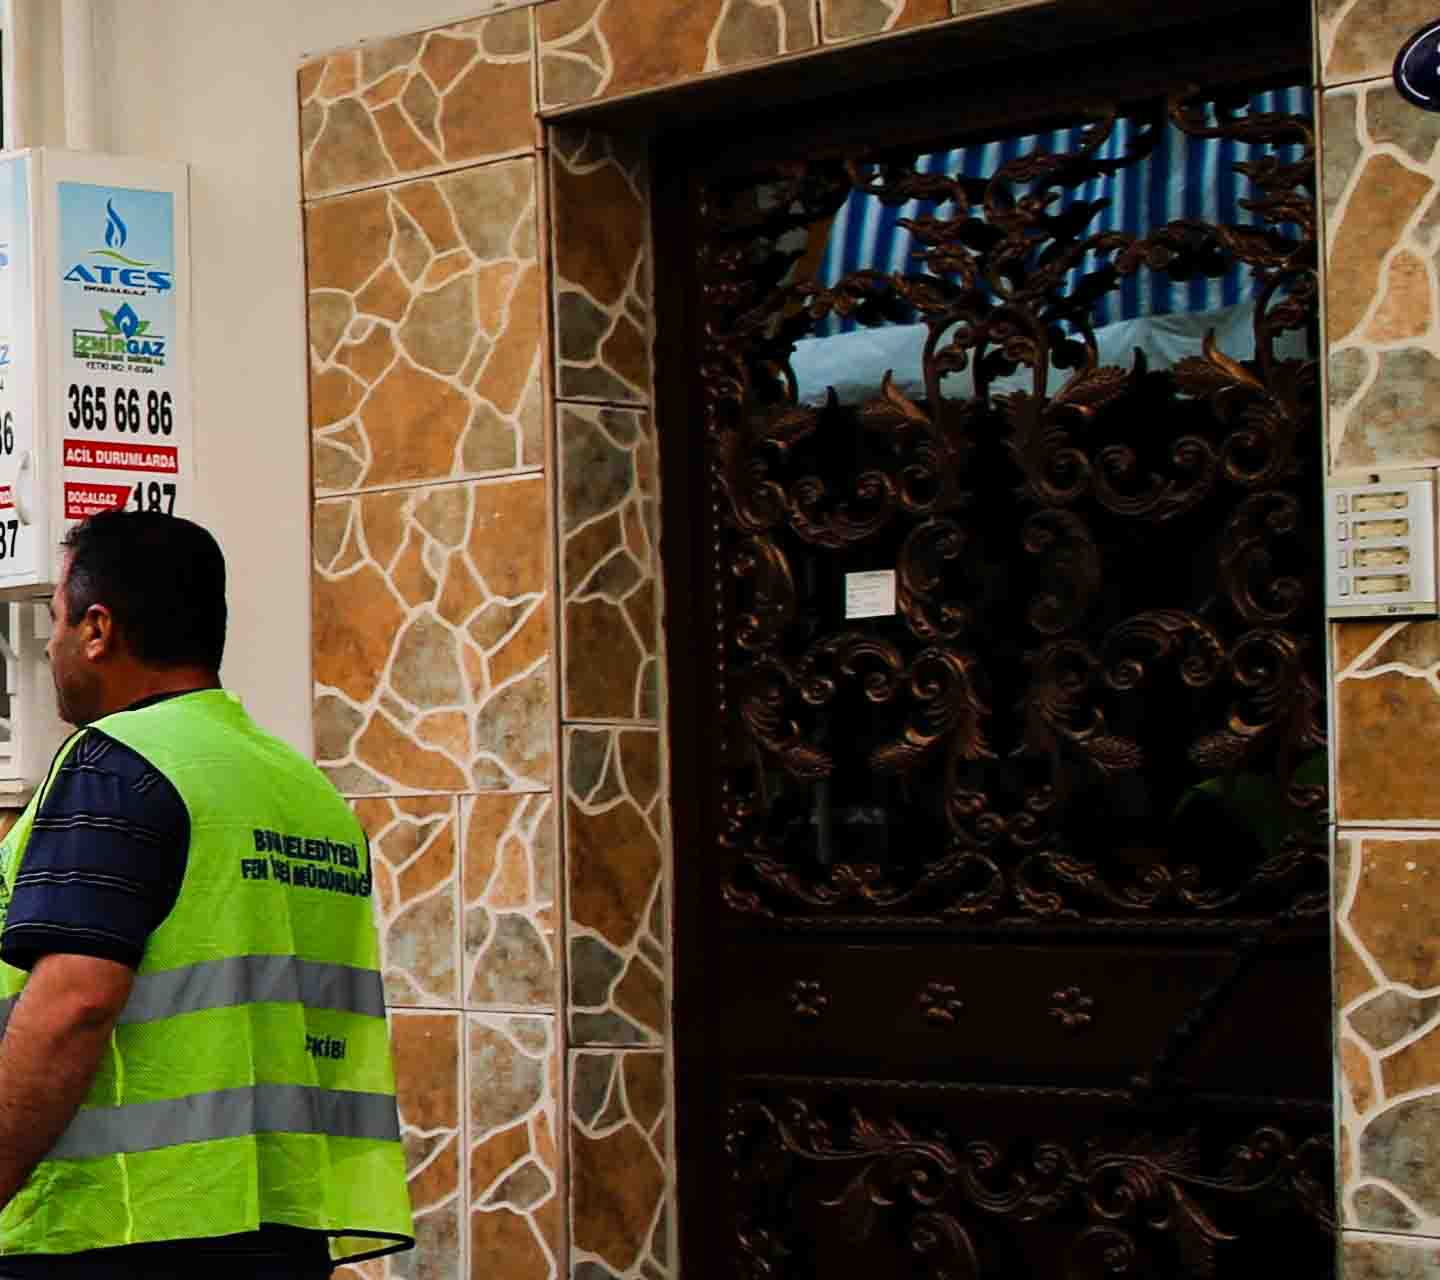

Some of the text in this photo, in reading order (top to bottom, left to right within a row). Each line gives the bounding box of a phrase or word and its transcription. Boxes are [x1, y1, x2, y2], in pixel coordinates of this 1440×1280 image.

[64, 264, 172, 293] ATEŞ
[68, 384, 172, 435] 365 66 86
[66, 446, 176, 468] ACİL DURUMLARDA
[133, 481, 176, 517] 187
